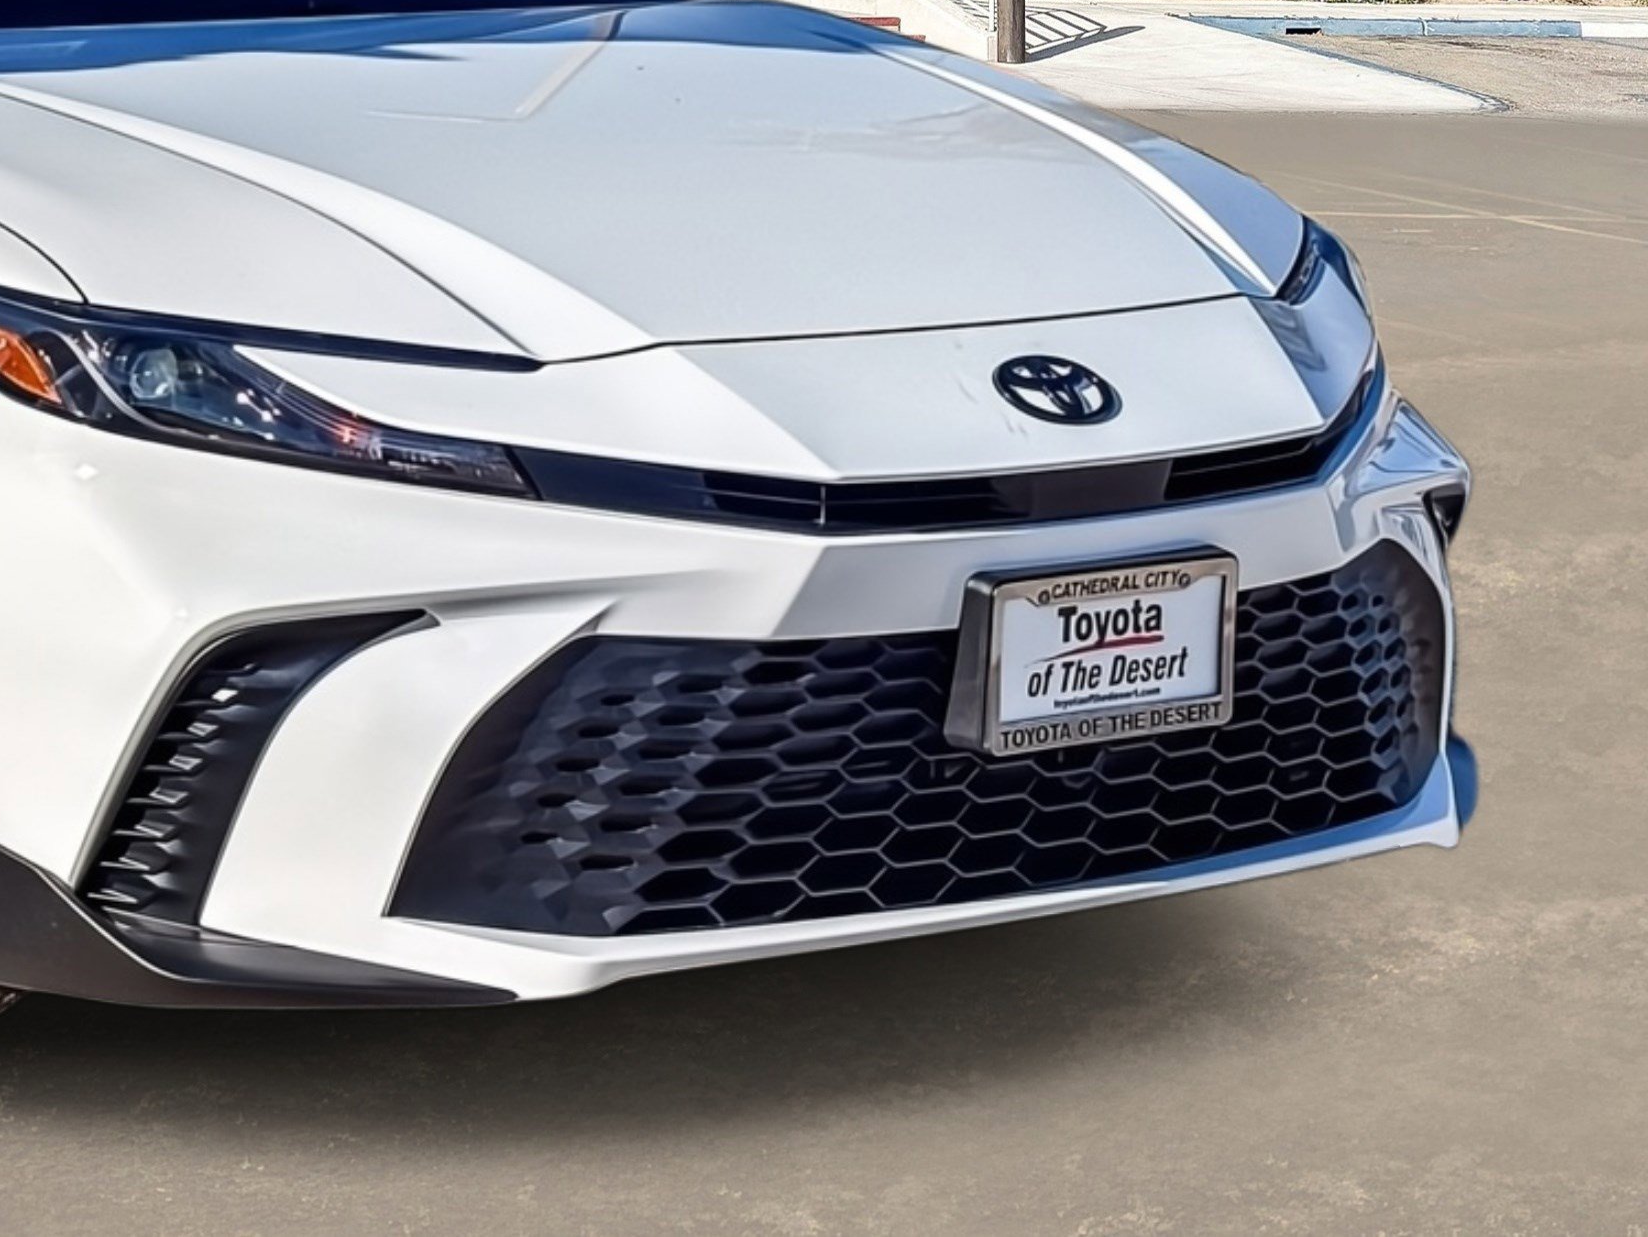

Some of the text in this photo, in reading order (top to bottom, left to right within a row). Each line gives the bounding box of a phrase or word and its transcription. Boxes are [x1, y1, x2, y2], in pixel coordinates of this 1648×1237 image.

[1052, 569, 1179, 599] CATHEDRAL CITY
[1058, 599, 1163, 644] Toyota
[1027, 646, 1188, 697] of The Desert
[1001, 701, 1223, 750] TOYOTA OF THE DESERT
